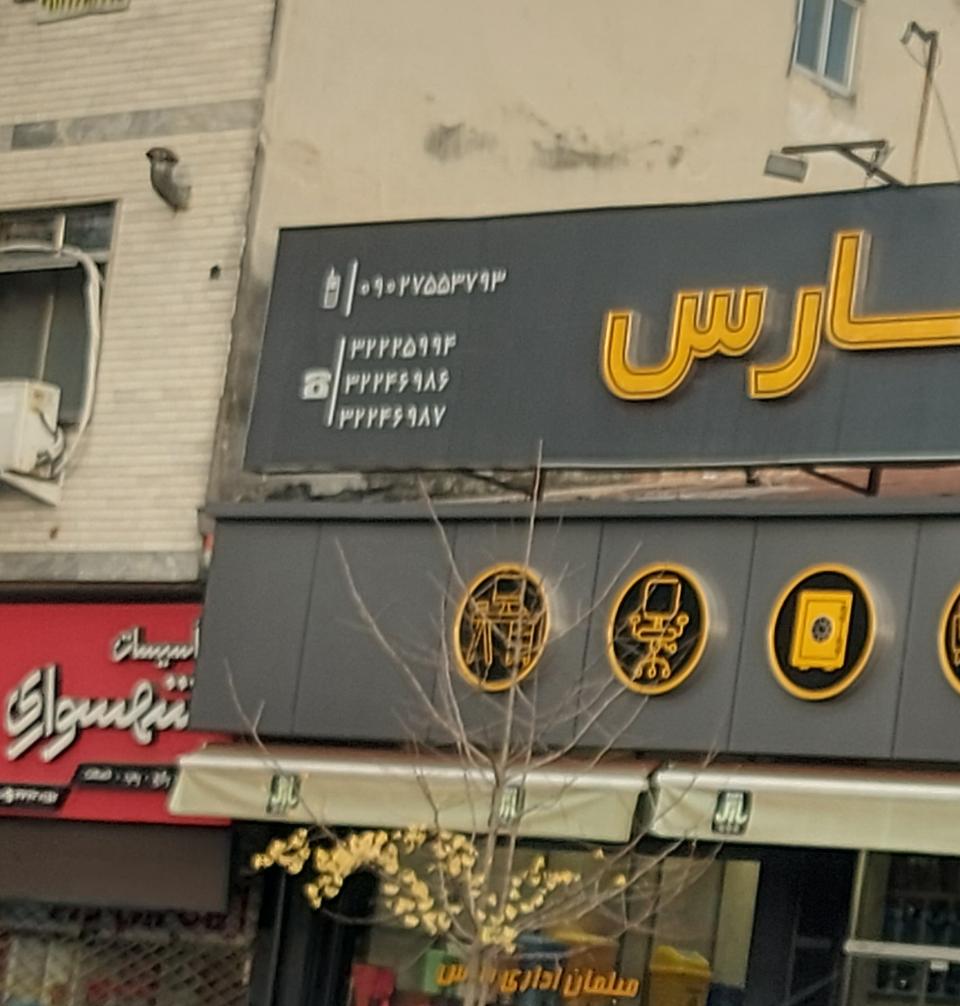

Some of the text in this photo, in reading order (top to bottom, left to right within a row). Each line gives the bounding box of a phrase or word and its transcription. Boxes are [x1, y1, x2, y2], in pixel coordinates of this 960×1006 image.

[112, 619, 200, 668] اسیسات
[500, 963, 563, 994] اداری
[563, 967, 640, 1003] مبلمان
